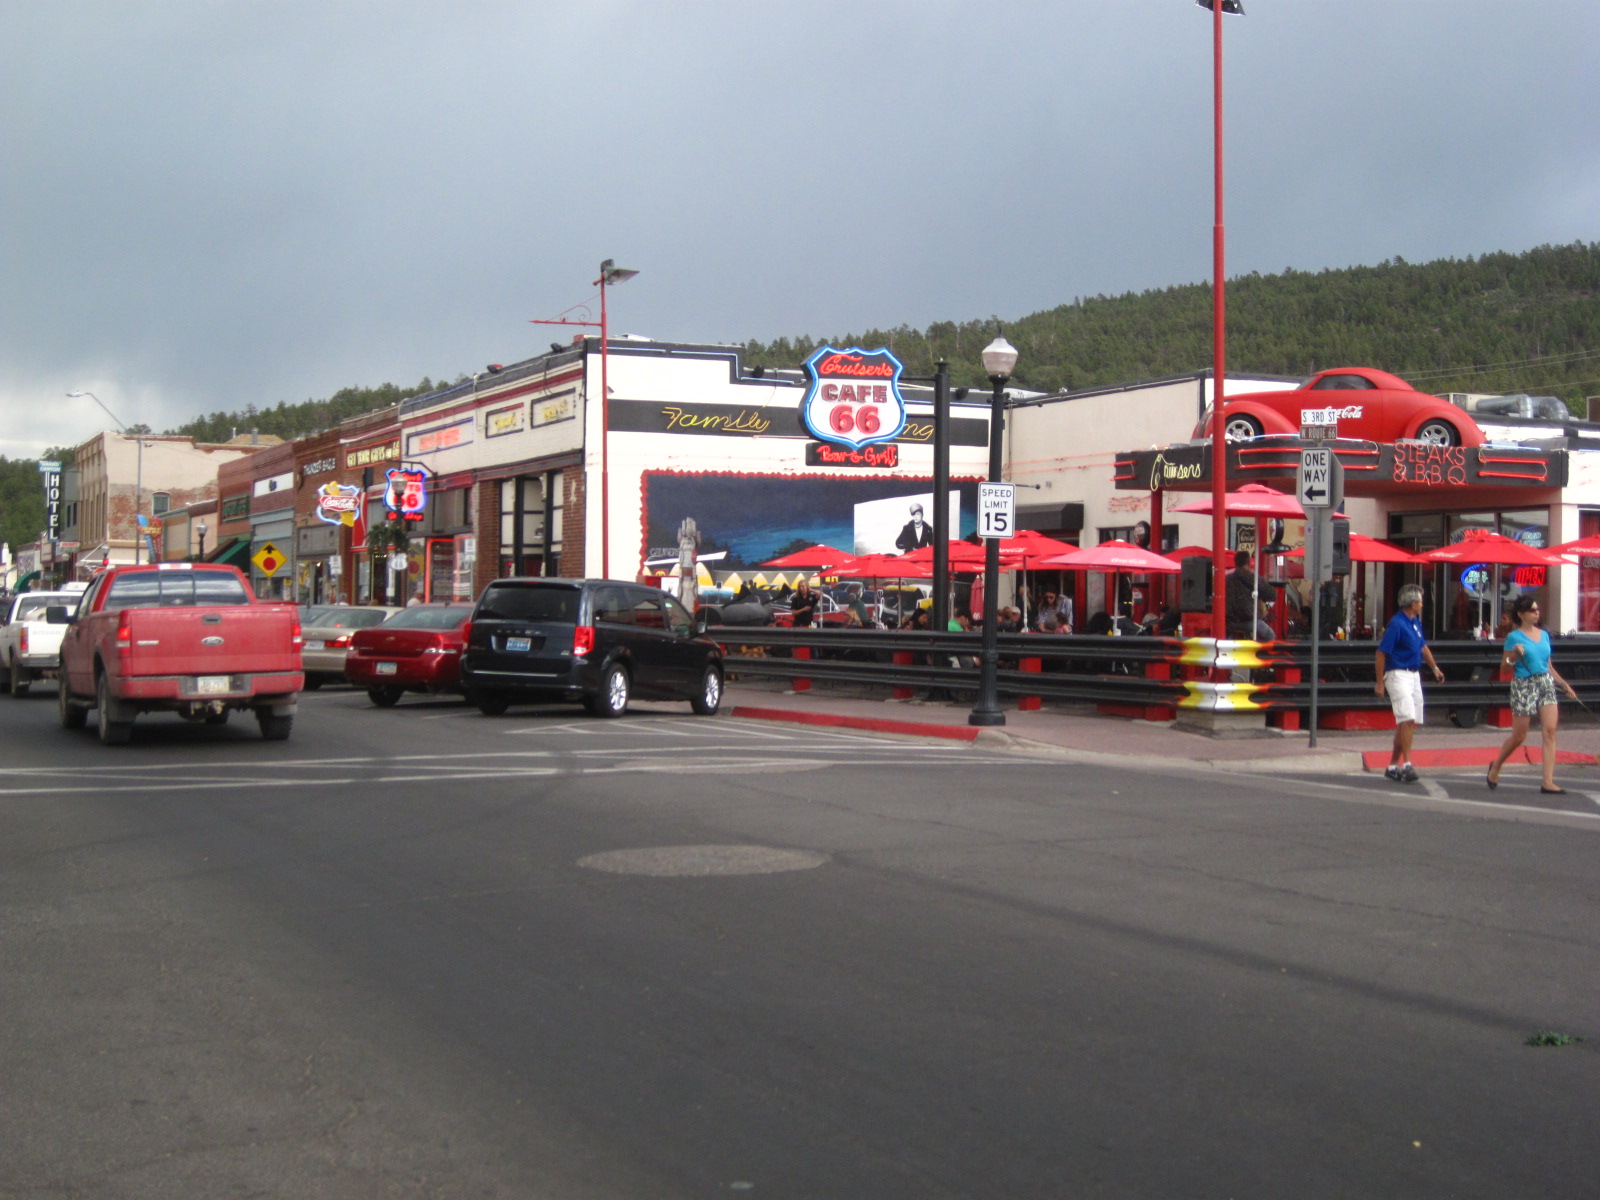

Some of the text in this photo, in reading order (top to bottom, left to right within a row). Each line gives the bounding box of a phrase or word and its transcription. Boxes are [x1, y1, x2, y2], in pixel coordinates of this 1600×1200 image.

[821, 383, 887, 403] CAFE
[661, 406, 770, 432] Family
[829, 404, 881, 434] 66
[1303, 411, 1336, 423] S 3RD ST
[1325, 406, 1363, 418] a-Cola
[1328, 427, 1336, 438] 66
[817, 445, 848, 462] Bar
[865, 446, 897, 466] Grill
[1305, 453, 1326, 466] ONE
[1394, 442, 1466, 466] STEAKS
[1304, 469, 1327, 483] WAY
[1393, 463, 1408, 482] &
[982, 488, 1012, 498] SPEED
[49, 474, 60, 540] HOTEL
[984, 501, 1008, 509] LIMIT
[984, 512, 1008, 532] 15
[1515, 567, 1544, 586] OPEN
